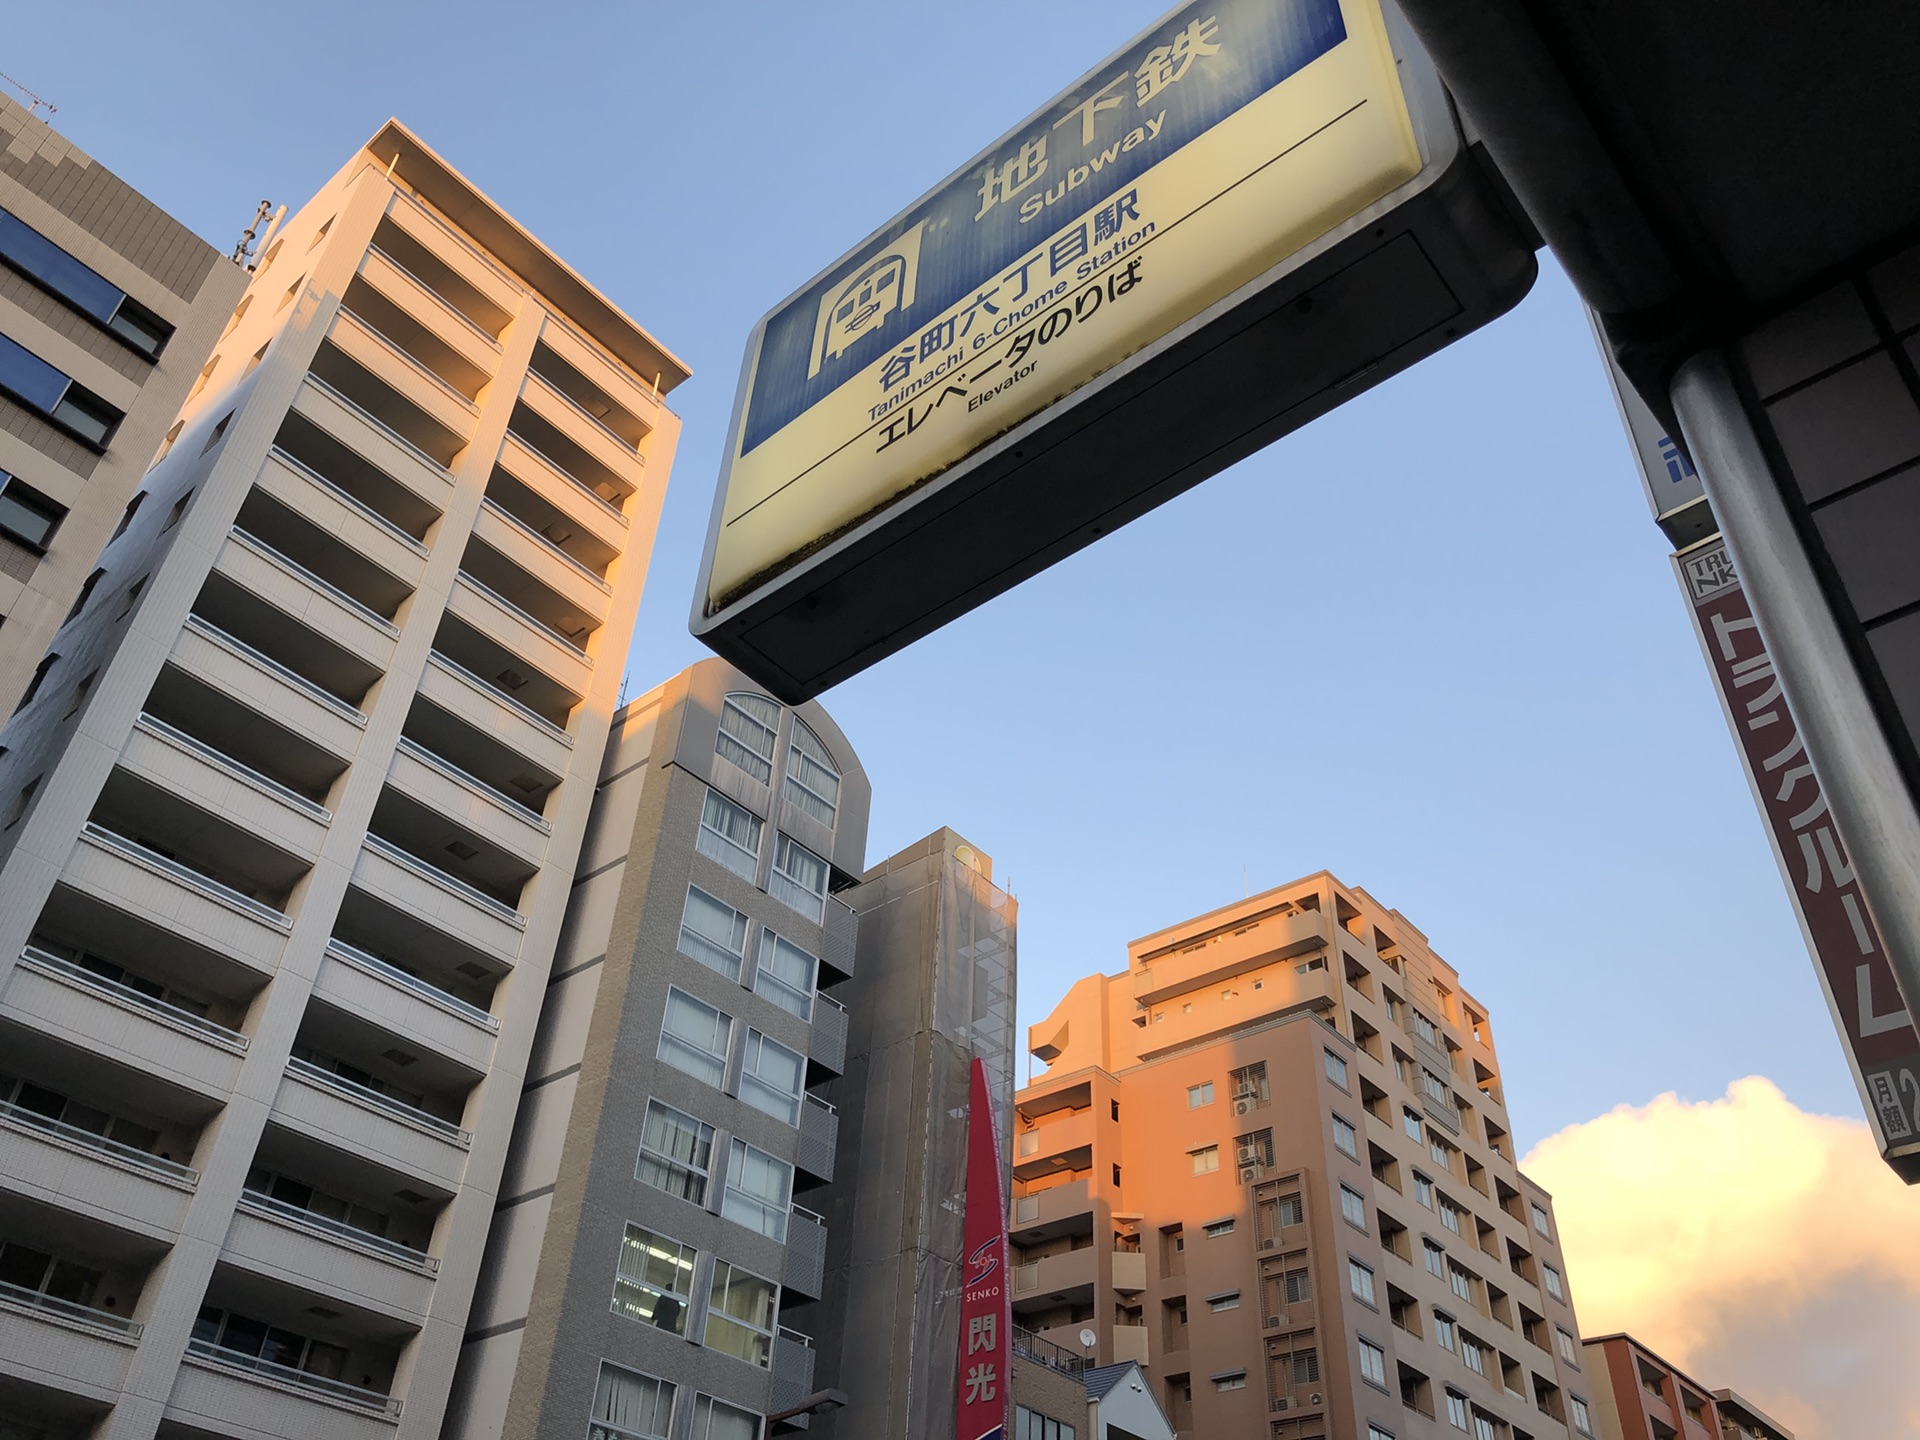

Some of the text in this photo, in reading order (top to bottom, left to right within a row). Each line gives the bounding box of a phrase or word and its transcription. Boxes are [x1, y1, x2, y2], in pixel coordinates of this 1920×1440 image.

[974, 15, 1222, 223] 地下鉄
[1018, 109, 1167, 224] Subway
[867, 222, 1156, 421] Tanimachi 6-Chome Station
[879, 188, 1140, 393] 谷町六丁目駅
[875, 256, 1143, 454] エレベータのりば
[967, 360, 1037, 413] Elevator
[1874, 1076, 1906, 1134] 月額
[966, 1287, 999, 1303] SENKO
[965, 1313, 997, 1405] 閃光
